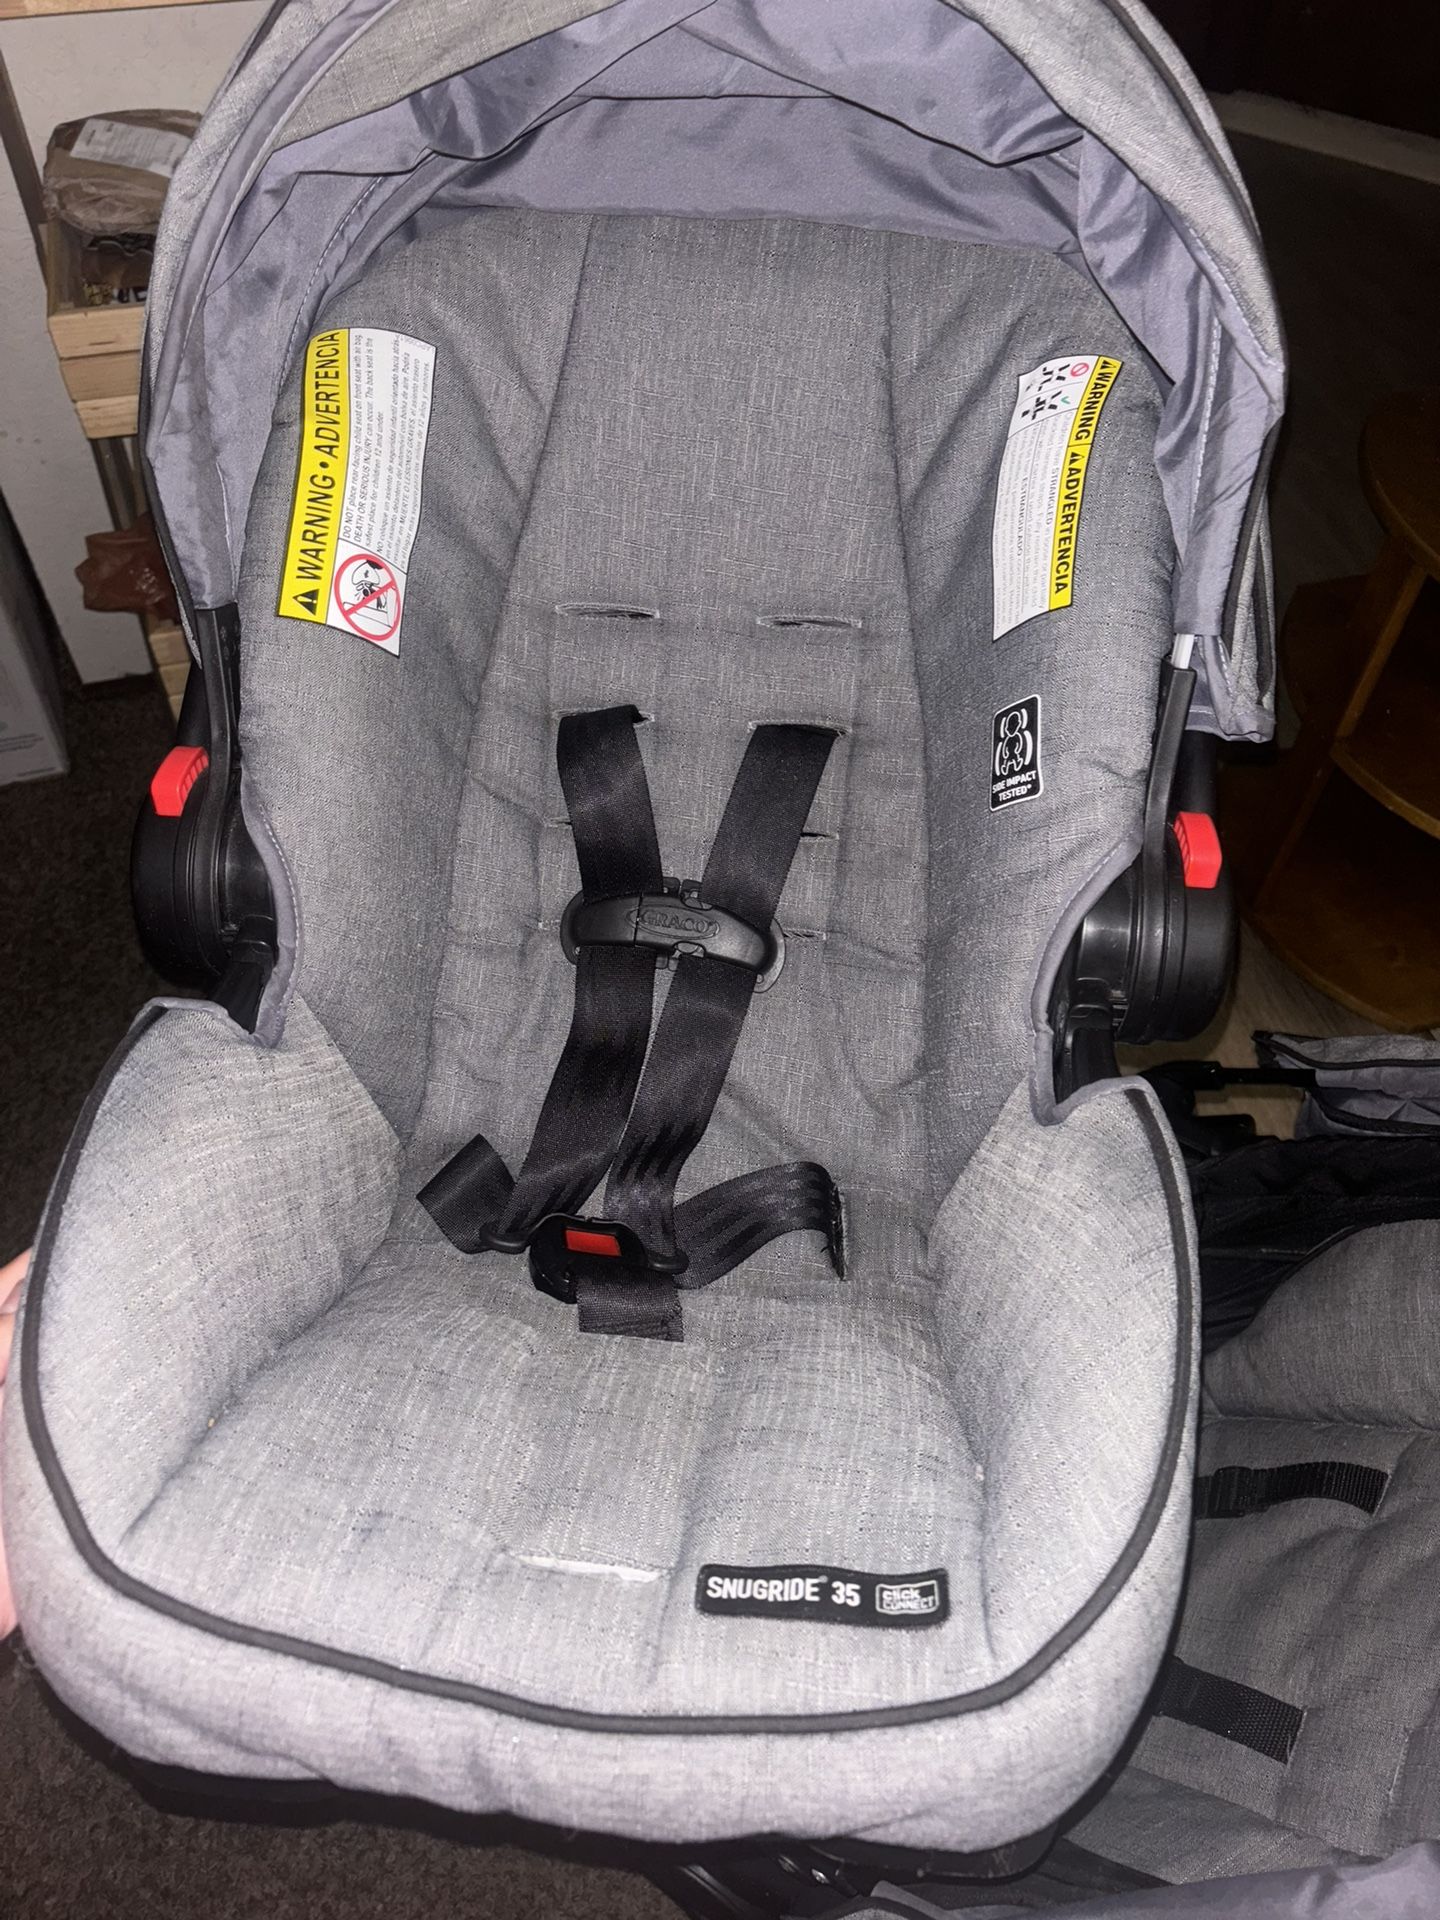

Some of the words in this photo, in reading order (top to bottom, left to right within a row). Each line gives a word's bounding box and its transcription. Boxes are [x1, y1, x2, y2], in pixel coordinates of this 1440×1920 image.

[354, 335, 363, 345] bag
[365, 355, 373, 369] seat
[391, 356, 399, 373] hacia
[365, 370, 373, 386] back
[314, 331, 342, 459] ADVERTENCIA
[365, 387, 373, 399] The
[391, 374, 399, 406] orientado
[1074, 368, 1112, 441] WARNING
[363, 435, 372, 465] INJURY
[374, 448, 382, 457] 12
[352, 446, 362, 485] rear-facing
[387, 465, 393, 474] de
[359, 465, 370, 500] SERIOUS
[385, 474, 393, 500] asiento
[399, 494, 409, 525] MUERTE
[404, 450, 412, 485] LESIONES
[348, 486, 357, 507] place
[357, 501, 365, 514] OR
[384, 502, 390, 511] un
[392, 480, 401, 513] delantero
[1045, 468, 1059, 525] STRANGLED
[344, 506, 353, 525] NOT
[368, 502, 376, 523] place
[296, 472, 336, 580] WARNING
[343, 526, 351, 538] DO
[354, 515, 364, 542] DEATH
[365, 524, 374, 547] safest
[379, 512, 388, 541] coloque
[1055, 467, 1082, 594] ADVERTENCIA
[377, 541, 384, 554] NO
[1006, 770, 1037, 787] IMPACT
[999, 785, 1028, 801] TESTED
[641, 909, 709, 934] GRACO
[706, 1575, 820, 1602] SNUGRIDE
[831, 1581, 861, 1607] 35
